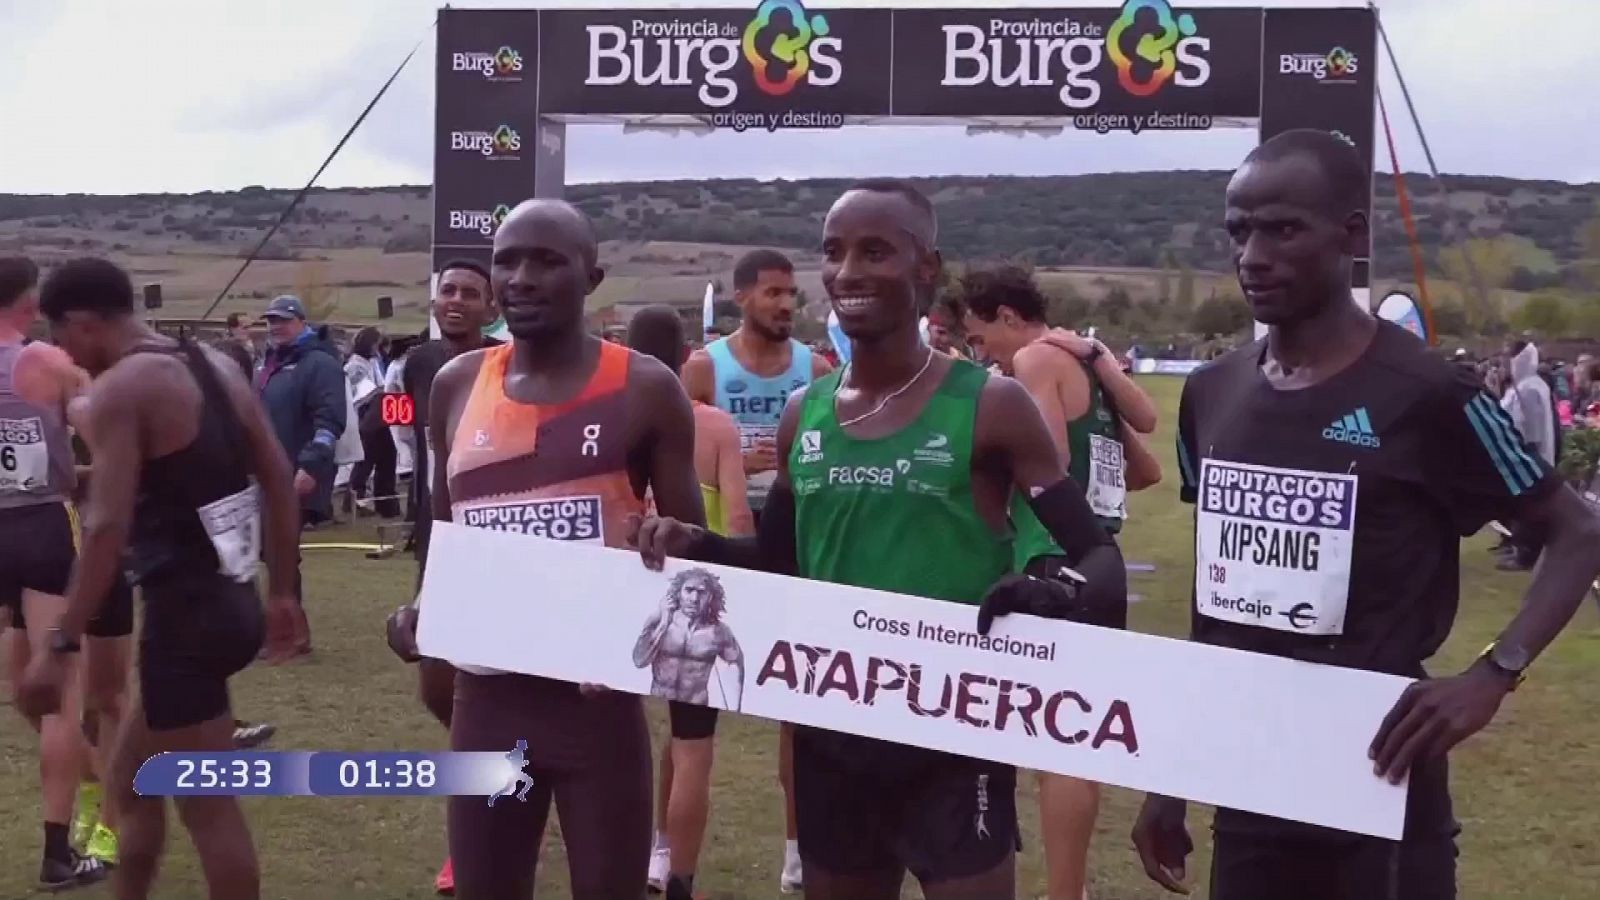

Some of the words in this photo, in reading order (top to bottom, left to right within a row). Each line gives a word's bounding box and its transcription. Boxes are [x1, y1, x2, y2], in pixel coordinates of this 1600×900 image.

[632, 19, 718, 37] Provincia
[721, 22, 738, 37] de
[990, 18, 1080, 37] Provincia
[1083, 22, 1101, 37] de
[714, 112, 764, 132] origen
[769, 115, 779, 132] y
[783, 110, 842, 127] destino
[1075, 112, 1128, 131] origen
[1133, 115, 1144, 132] y
[1147, 110, 1211, 128] destino
[1322, 426, 1381, 448] adidas
[1208, 466, 1345, 501] DIPUTACIÓN
[466, 499, 592, 527] DIPUTACIÓN
[1206, 486, 1344, 527] BURGOS
[1218, 519, 1321, 572] KIPSANG
[1208, 563, 1227, 585] 138
[852, 609, 911, 637] Cross
[916, 613, 1056, 662] Internacional
[756, 639, 1140, 756] ATAPUERCA
